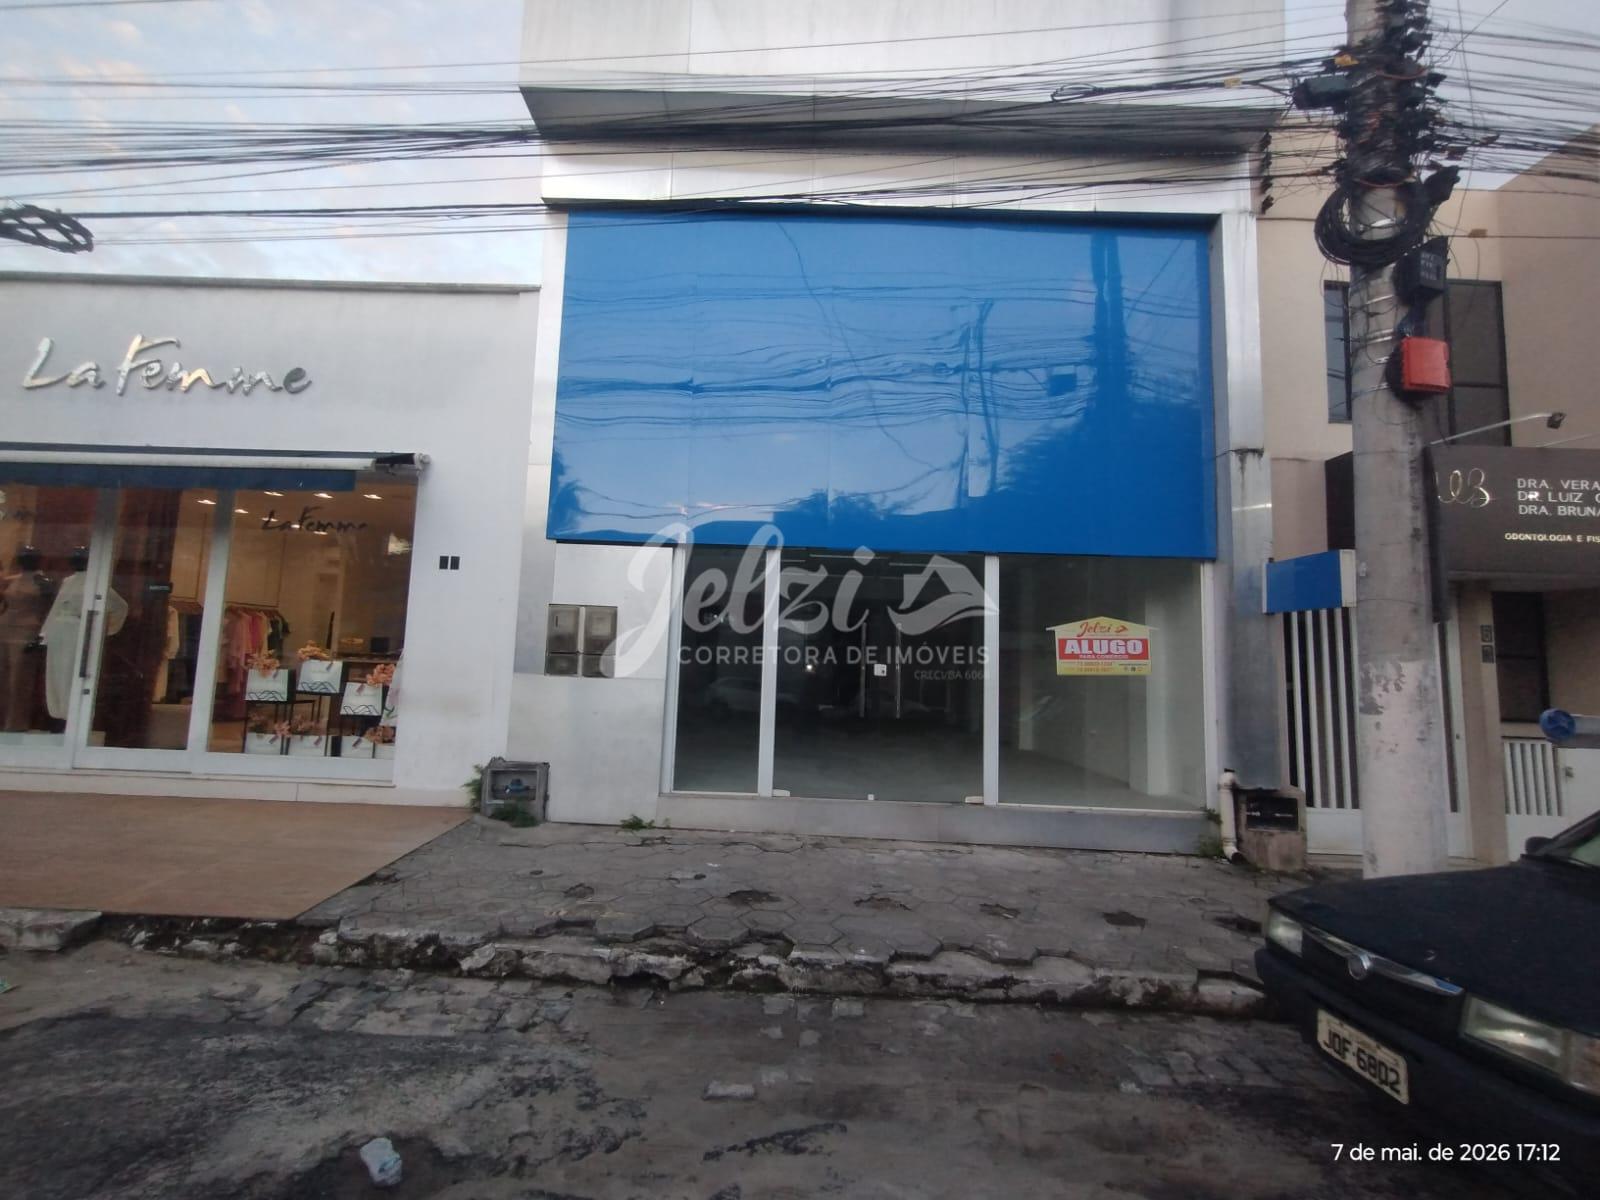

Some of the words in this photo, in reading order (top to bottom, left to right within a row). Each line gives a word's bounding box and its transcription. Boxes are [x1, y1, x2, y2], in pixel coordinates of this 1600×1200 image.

[23, 337, 106, 389] La
[1548, 491, 1583, 503] LUIZ
[1519, 504, 1552, 516] DRA.
[1504, 532, 1573, 542] ODONTOLOGIA
[1064, 639, 1143, 655] ALUGO
